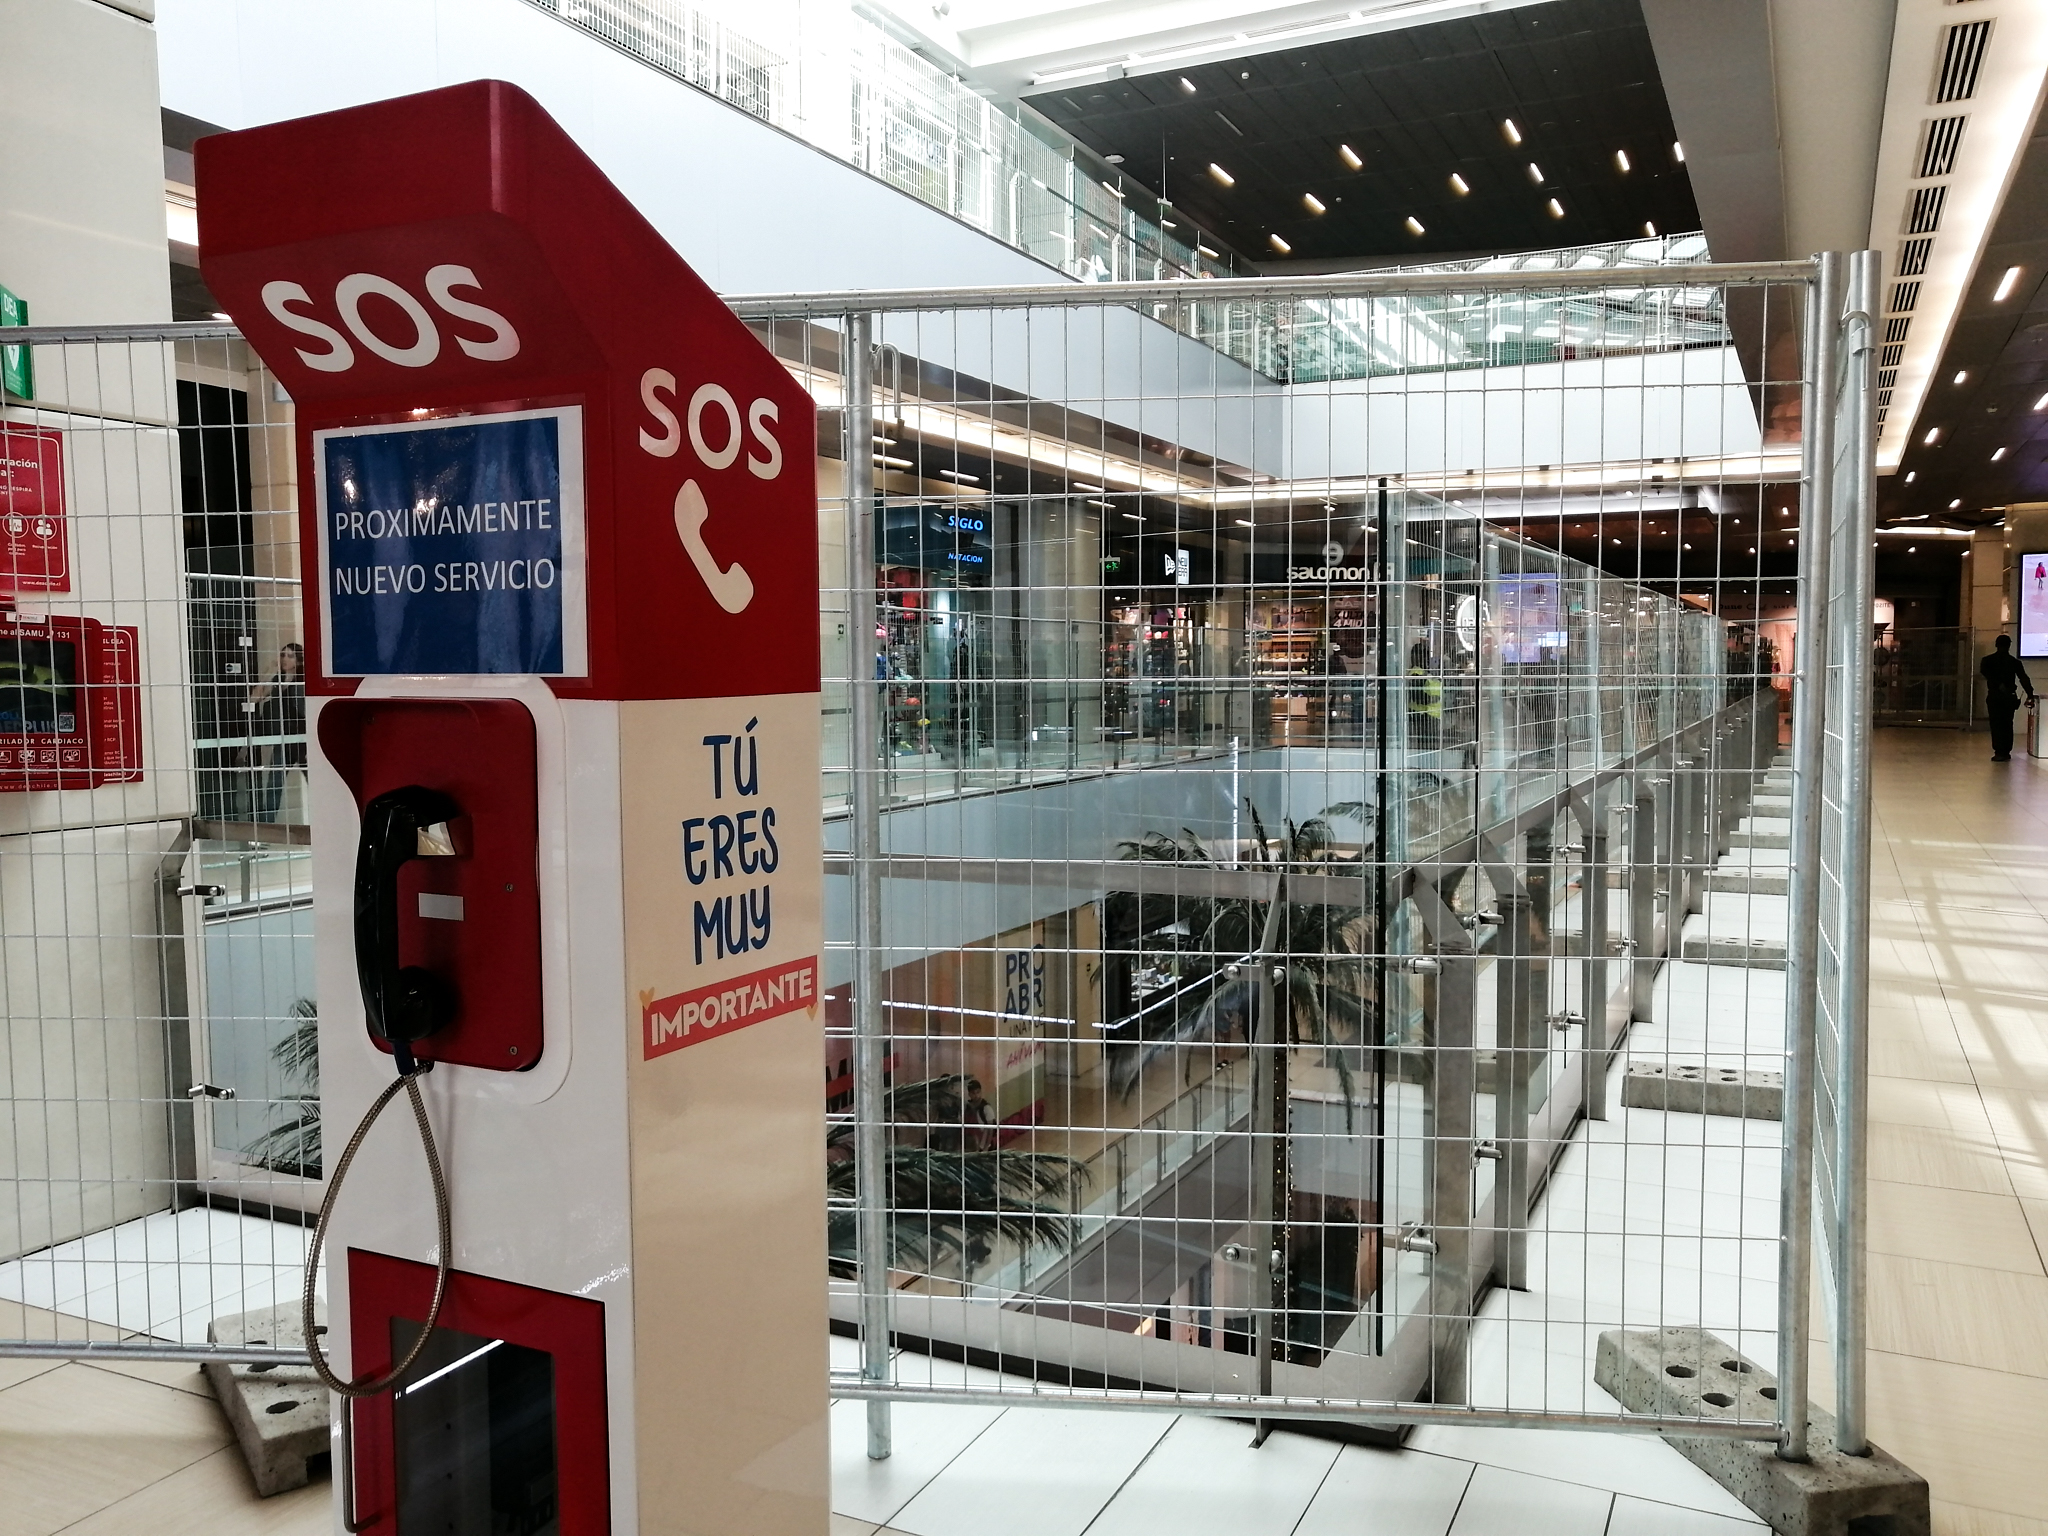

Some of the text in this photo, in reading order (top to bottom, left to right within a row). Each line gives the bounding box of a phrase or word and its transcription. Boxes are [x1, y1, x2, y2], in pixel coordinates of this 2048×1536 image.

[3, 293, 19, 320] DEA
[261, 264, 520, 373] SOS
[639, 367, 783, 480] SOS
[335, 498, 553, 541] PROXIMAMENTE
[948, 515, 984, 531] SIGLO
[335, 558, 556, 596] NUEVO SERVICIO
[948, 552, 984, 563] NATACION
[40, 737, 84, 745] CARDIACO
[702, 716, 759, 800] TÚ
[682, 806, 779, 886] ERES
[693, 884, 771, 966] MUY
[1005, 943, 1044, 988] PRO
[650, 967, 813, 1047] IMPORTANTE
